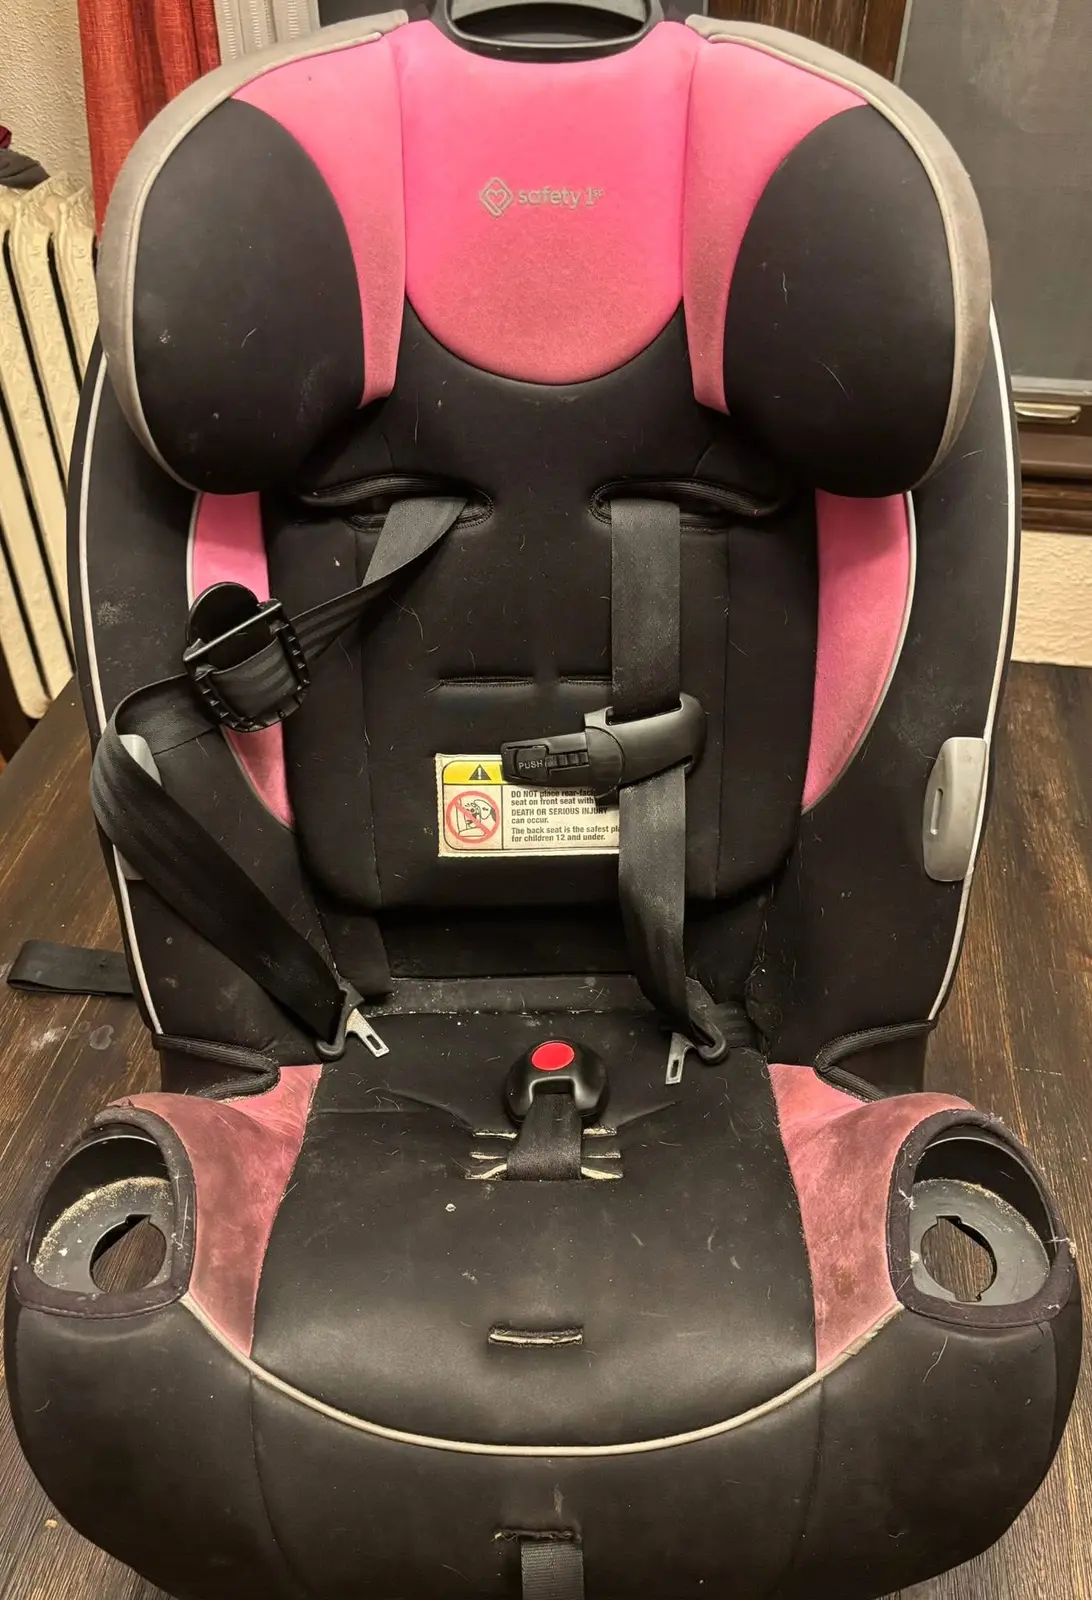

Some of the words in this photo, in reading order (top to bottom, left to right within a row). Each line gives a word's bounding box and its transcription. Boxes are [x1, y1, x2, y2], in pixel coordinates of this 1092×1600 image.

[518, 186, 580, 210] safety
[518, 760, 543, 769] PUSH
[511, 790, 521, 798] DO
[523, 790, 538, 798] NOT
[540, 789, 560, 798] place
[561, 788, 595, 797] rear-faci
[540, 797, 558, 805] front
[560, 797, 576, 805] seat
[577, 796, 595, 804] with
[511, 808, 534, 816] DEATH
[536, 808, 547, 816] OR
[548, 807, 580, 815] SERIOUS
[581, 806, 608, 815] INJURY
[511, 827, 525, 835] The
[526, 826, 545, 834] back
[546, 826, 562, 834] seat
[564, 825, 571, 833] is
[572, 825, 585, 833] the
[586, 825, 609, 833] safest
[610, 825, 621, 834] pla
[511, 835, 522, 843] for
[523, 834, 554, 842] children
[567, 833, 581, 841] and
[582, 833, 606, 841] under.
